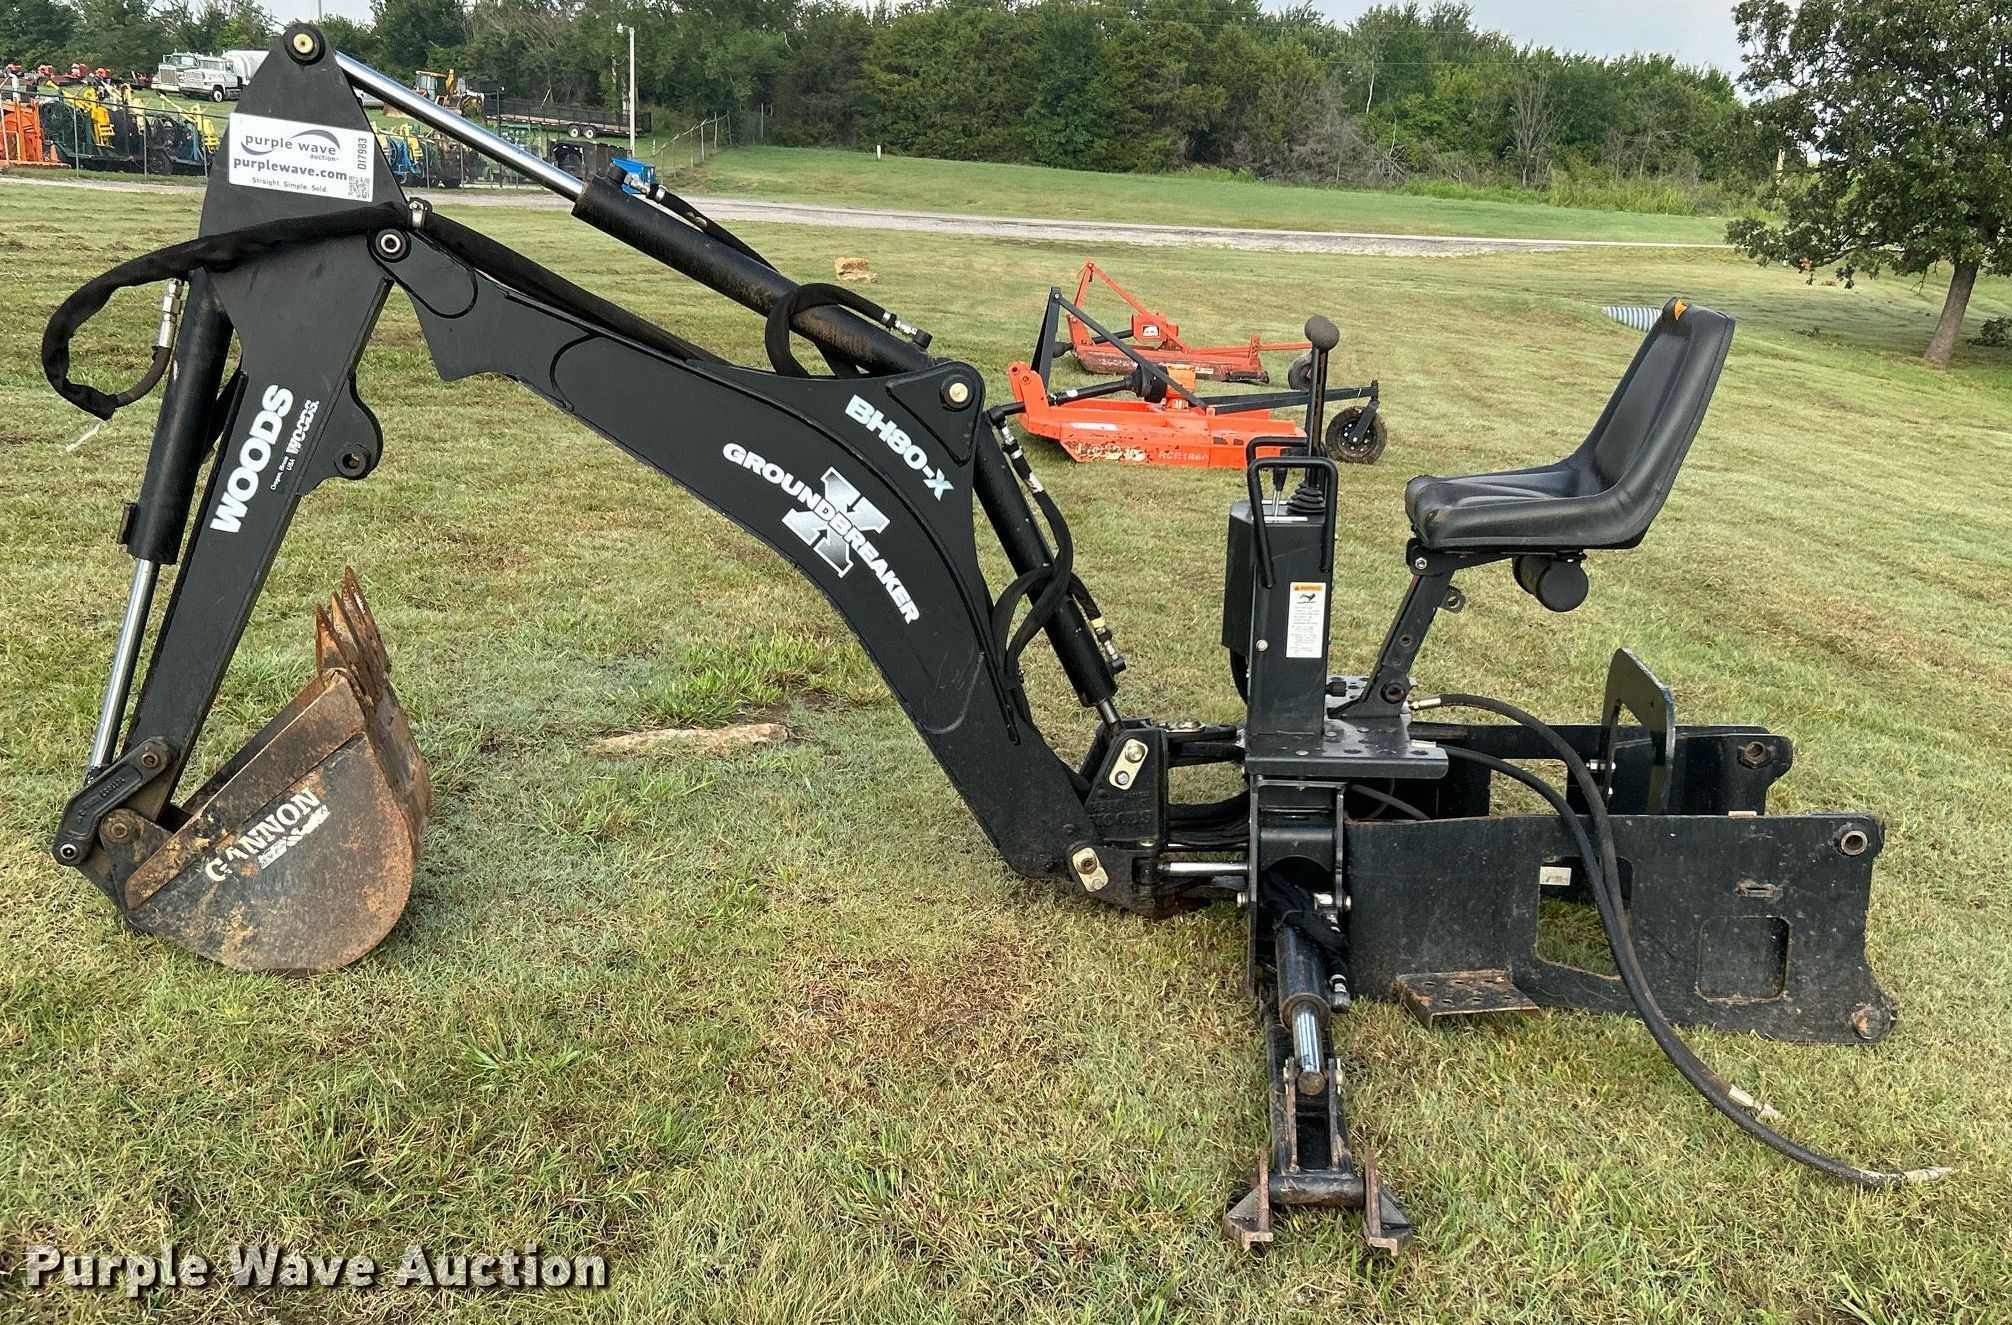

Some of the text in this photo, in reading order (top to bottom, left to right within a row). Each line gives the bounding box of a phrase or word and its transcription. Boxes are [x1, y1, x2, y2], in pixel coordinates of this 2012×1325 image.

[233, 157, 348, 181] purplewave.com
[245, 134, 337, 155] purple wave
[210, 384, 294, 533] WOODS
[845, 394, 954, 501] BH80-X
[722, 442, 921, 624] GROUNDBREAKER
[205, 787, 320, 882] GANNON
